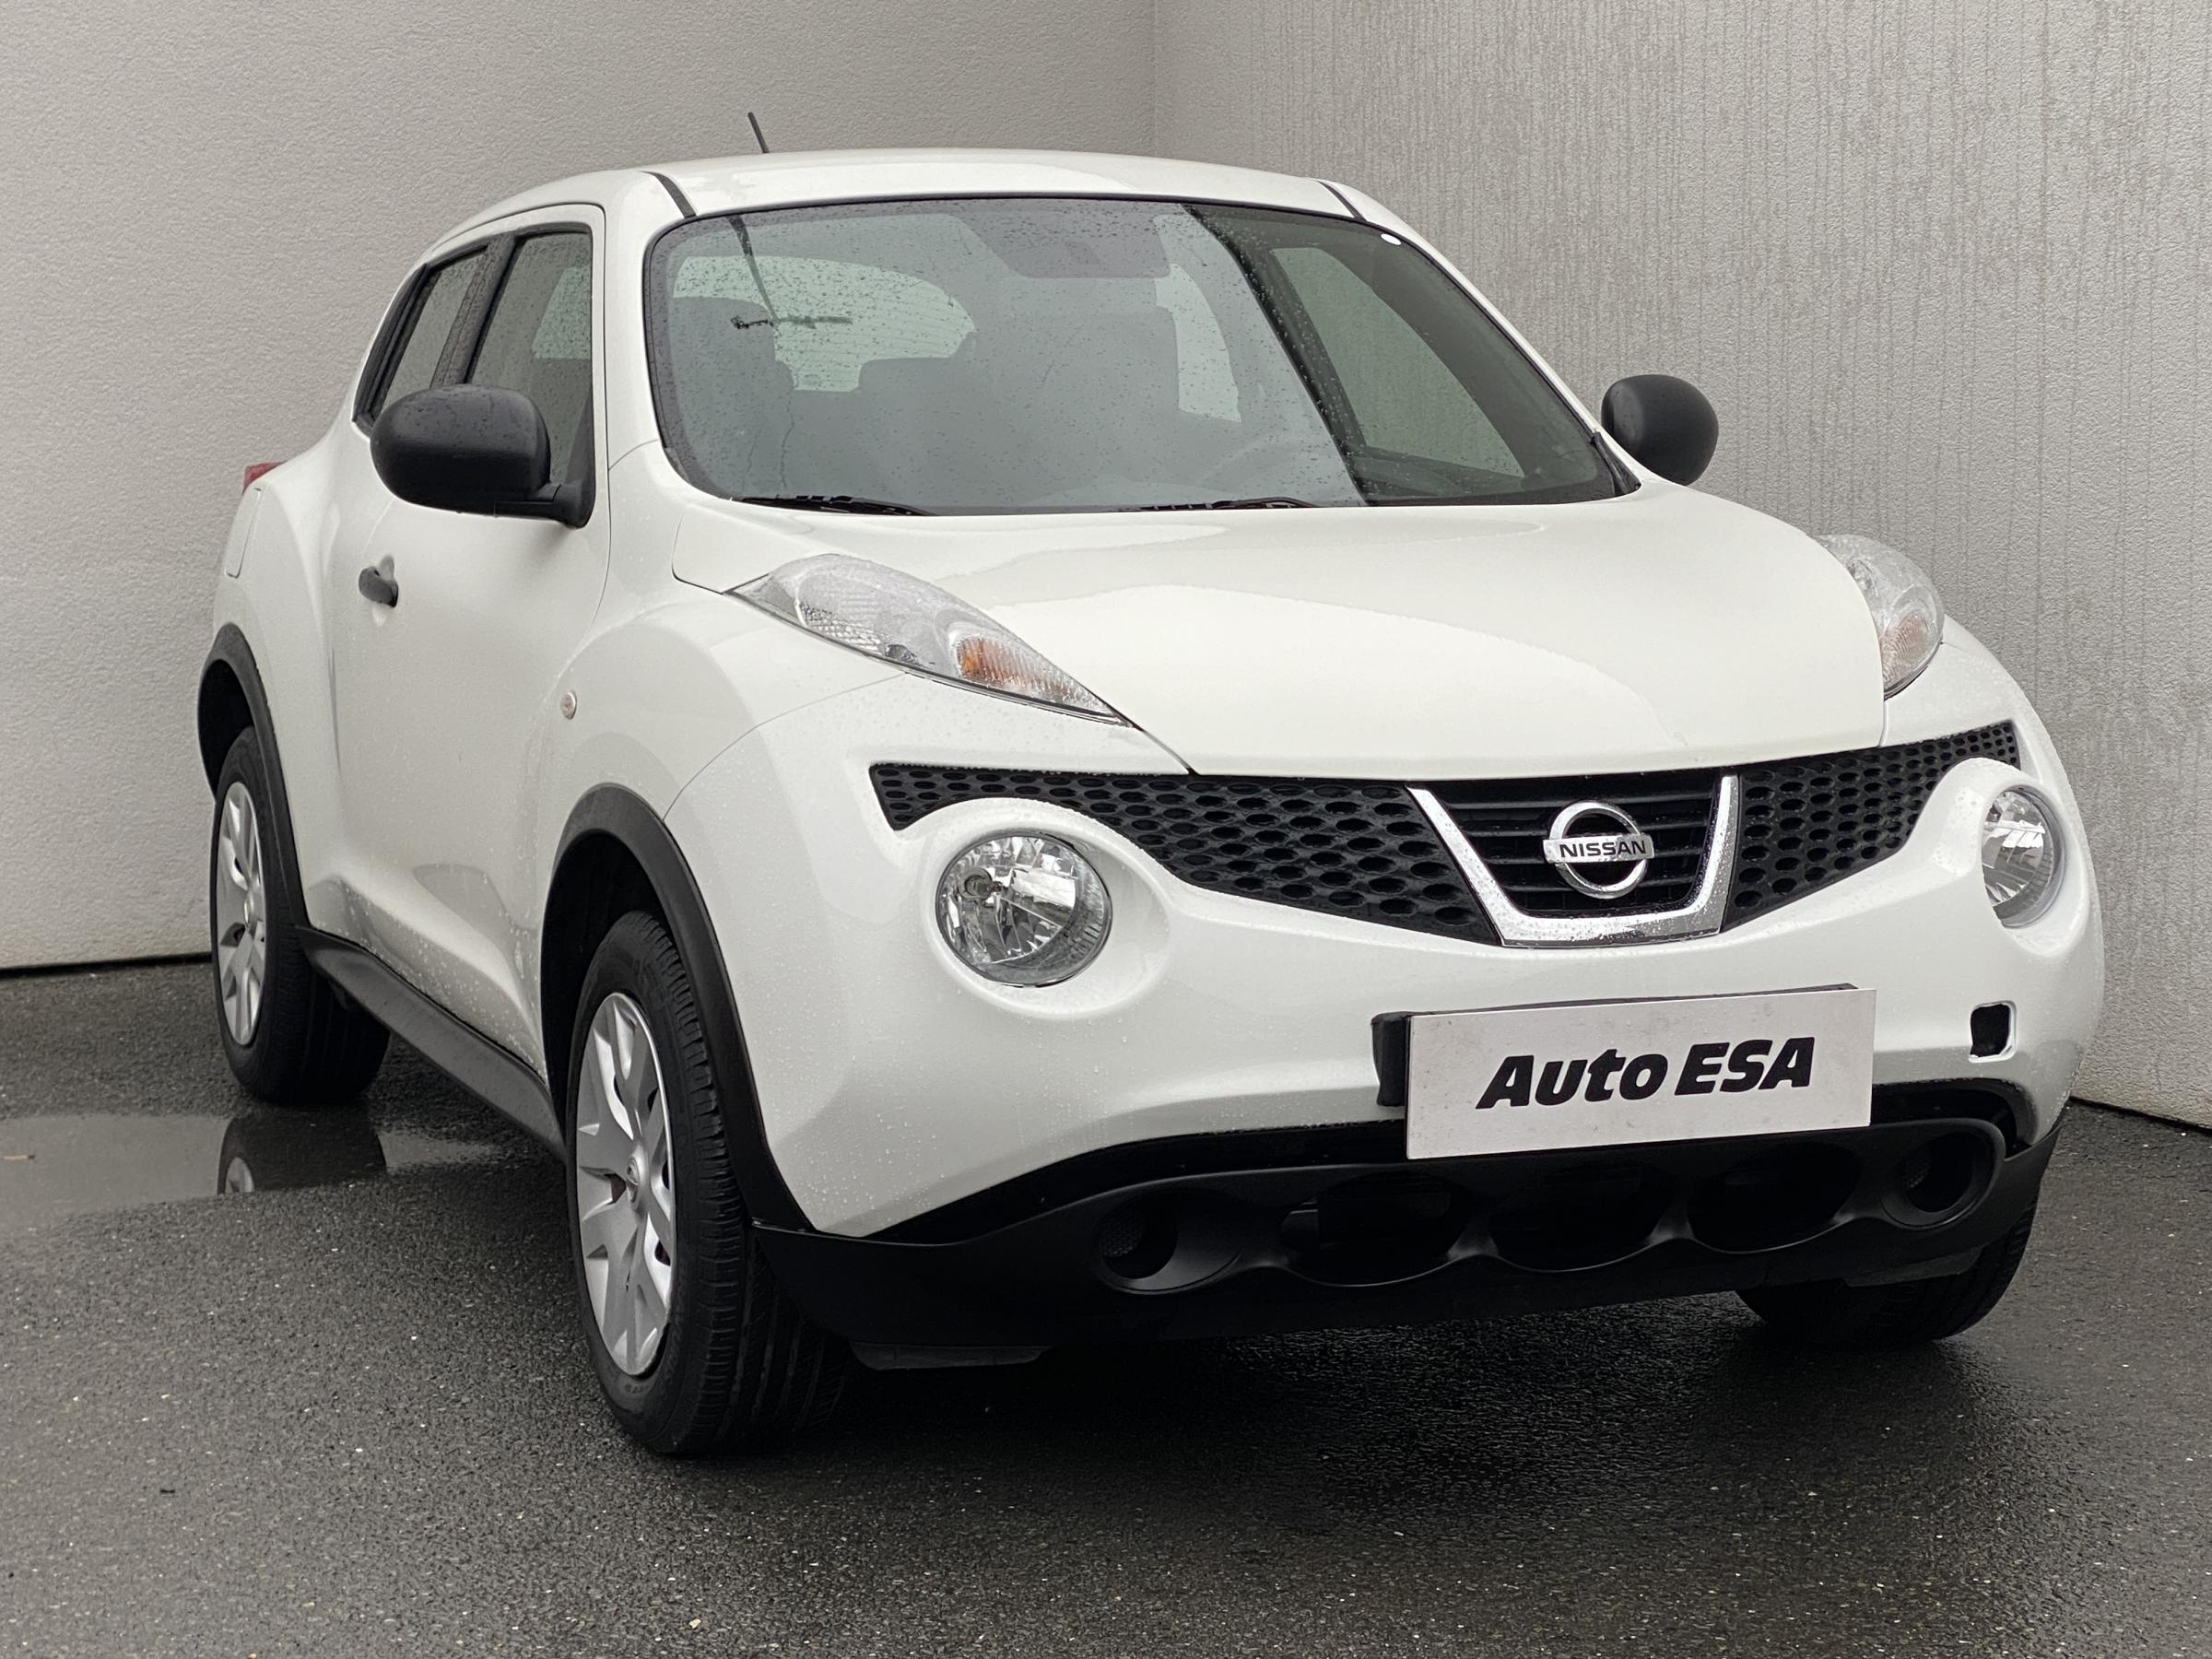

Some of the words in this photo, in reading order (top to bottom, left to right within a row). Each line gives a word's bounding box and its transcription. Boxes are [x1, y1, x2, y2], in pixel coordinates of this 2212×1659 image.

[1558, 840, 1647, 858] NISSAN
[1475, 1049, 1668, 1110] Auto
[1674, 1037, 1816, 1096] ESA
